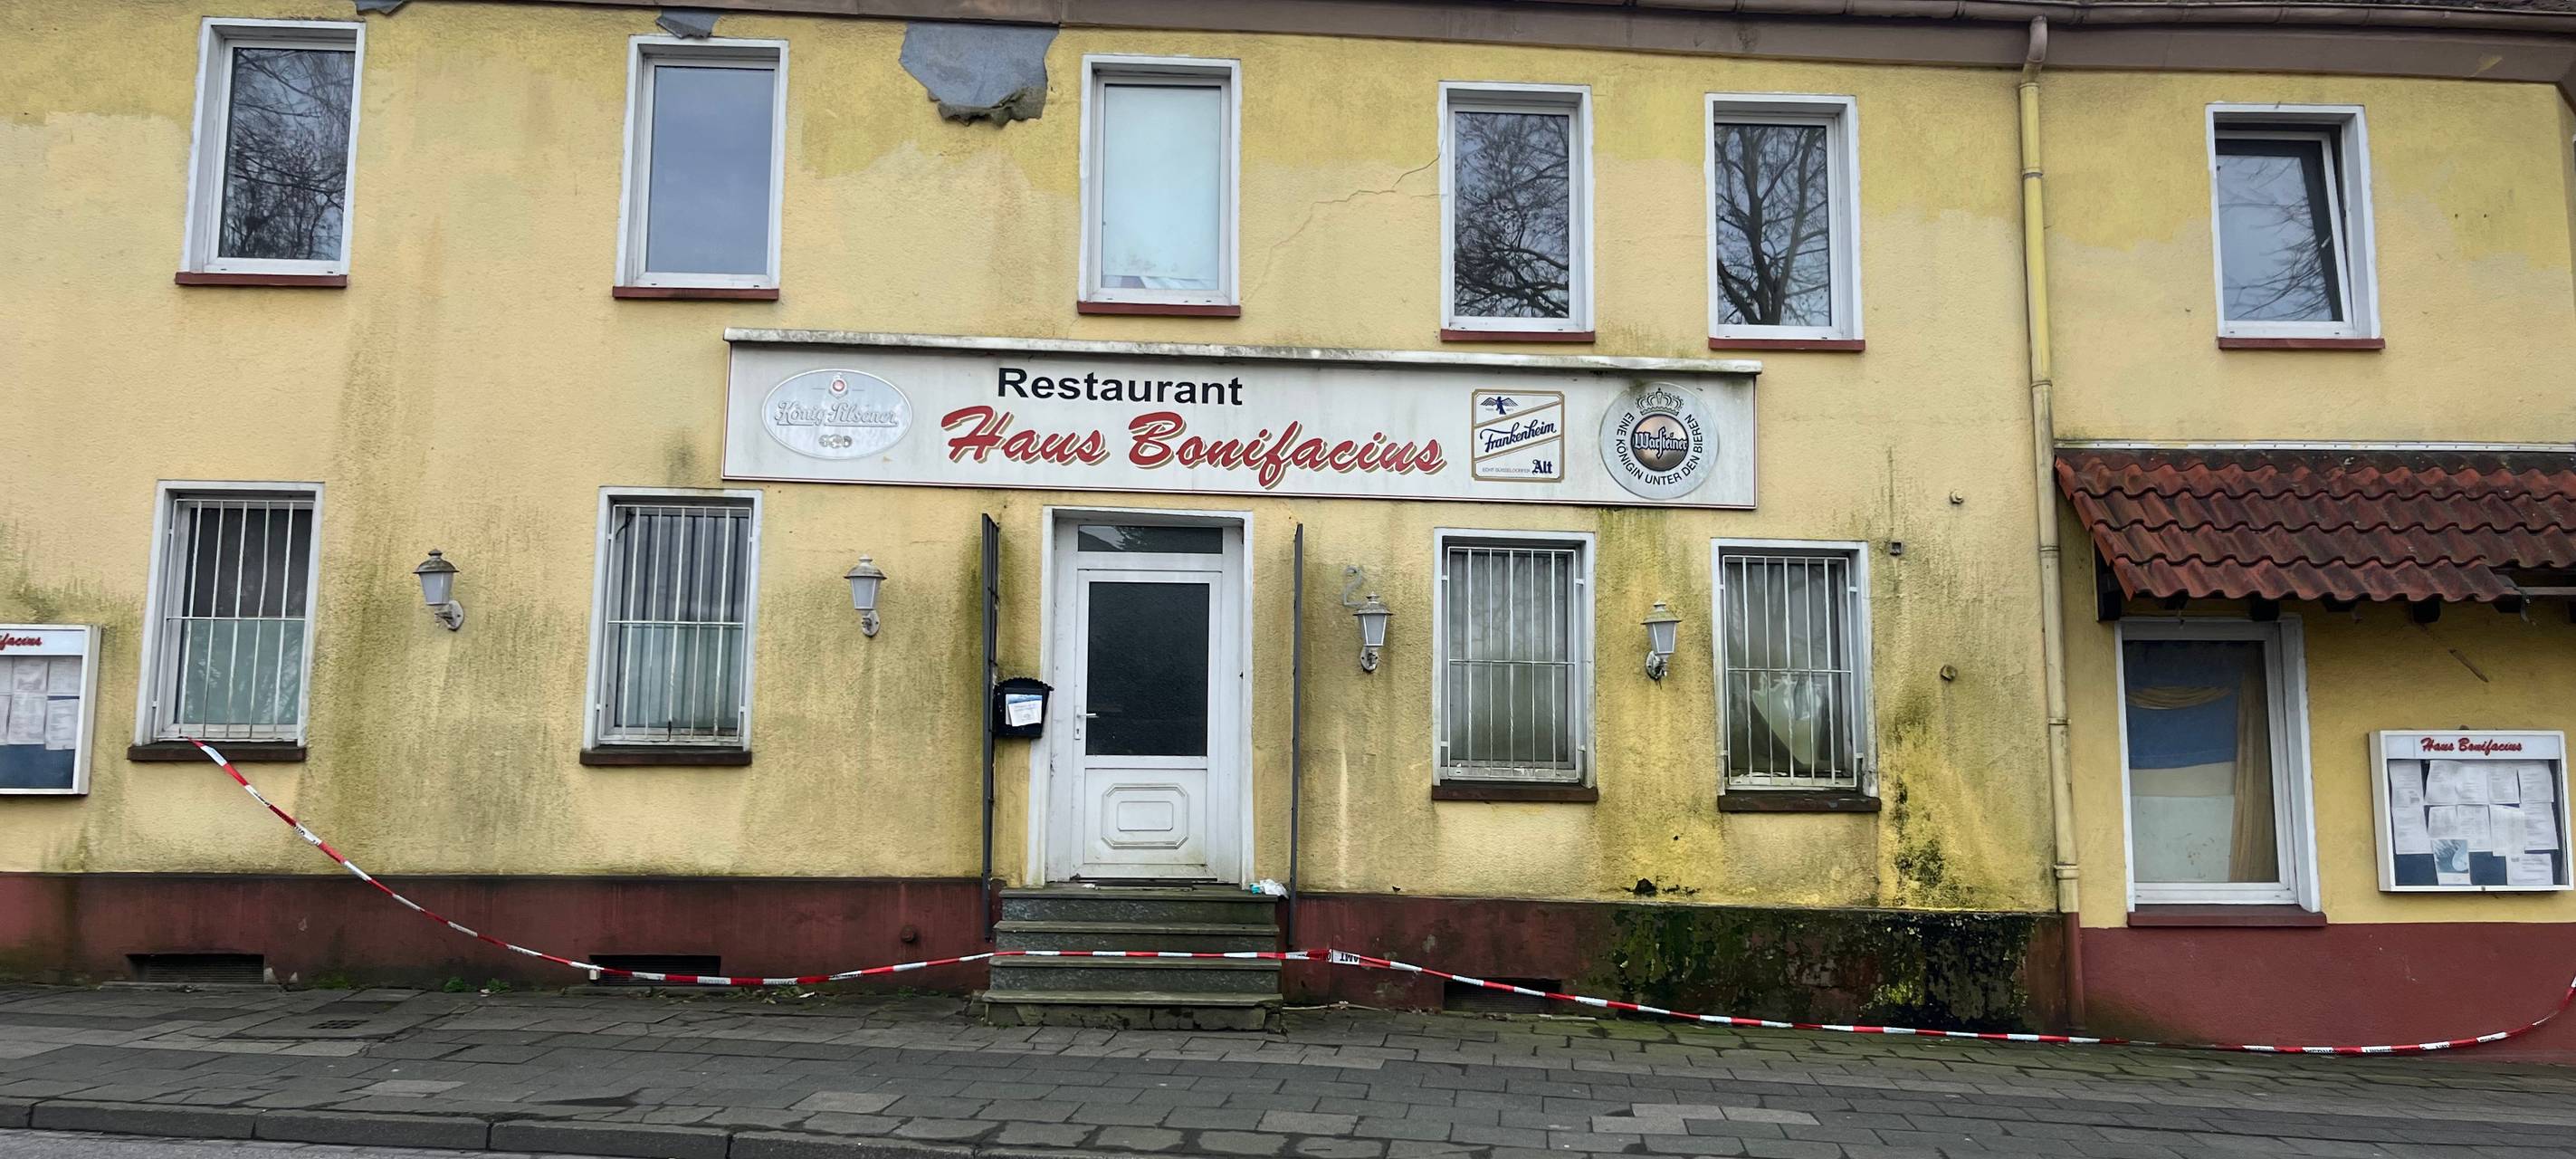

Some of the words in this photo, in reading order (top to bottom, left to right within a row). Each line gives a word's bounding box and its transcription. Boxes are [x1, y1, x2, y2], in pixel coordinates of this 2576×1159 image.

[997, 368, 1243, 406] Restaurant
[1479, 419, 1557, 453] Frankenheim
[1617, 412, 1635, 436] EINE
[1684, 414, 1703, 454] BIEREN
[941, 406, 1109, 465] Haus
[1128, 411, 1446, 490] Bonifacius
[1616, 438, 1644, 480] KÖNIGIN
[1531, 459, 1552, 474] Alt
[1645, 472, 1683, 485] UNTER
[1681, 455, 1701, 476] DEN
[2420, 737, 2455, 752] Haus
[2458, 737, 2523, 756] Bonifacius
